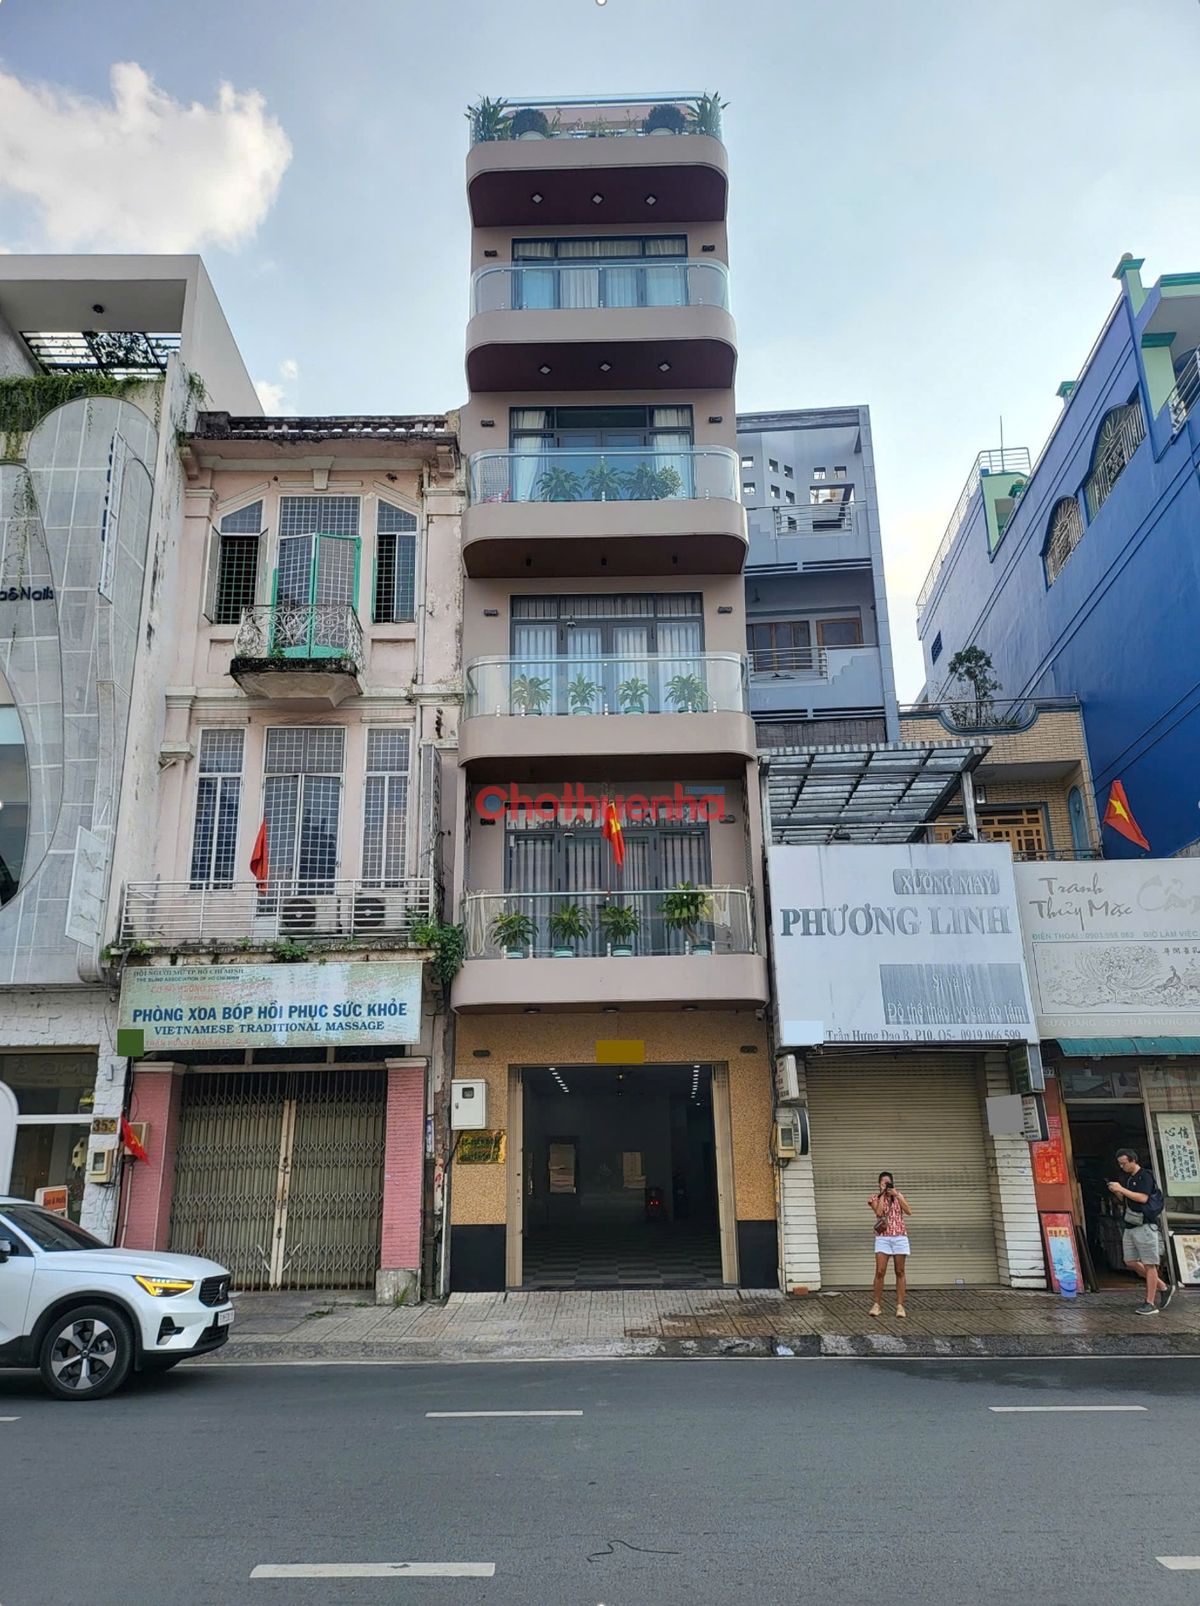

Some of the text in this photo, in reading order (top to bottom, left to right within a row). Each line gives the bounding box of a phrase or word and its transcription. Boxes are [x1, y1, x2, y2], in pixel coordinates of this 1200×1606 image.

[959, 874, 994, 891] MAY
[1038, 872, 1104, 895] Tranh
[780, 903, 1013, 937] PHƯƠNG LINH
[1029, 898, 1133, 931] Thủy Mặc
[132, 997, 407, 1023] PHÒNG XOA BÓP HỒI PHỤC SỨC KHỎE
[154, 1021, 385, 1036] VIETNAMESE TRADITIONAL MASSAGE
[93, 1119, 117, 1133] 353
